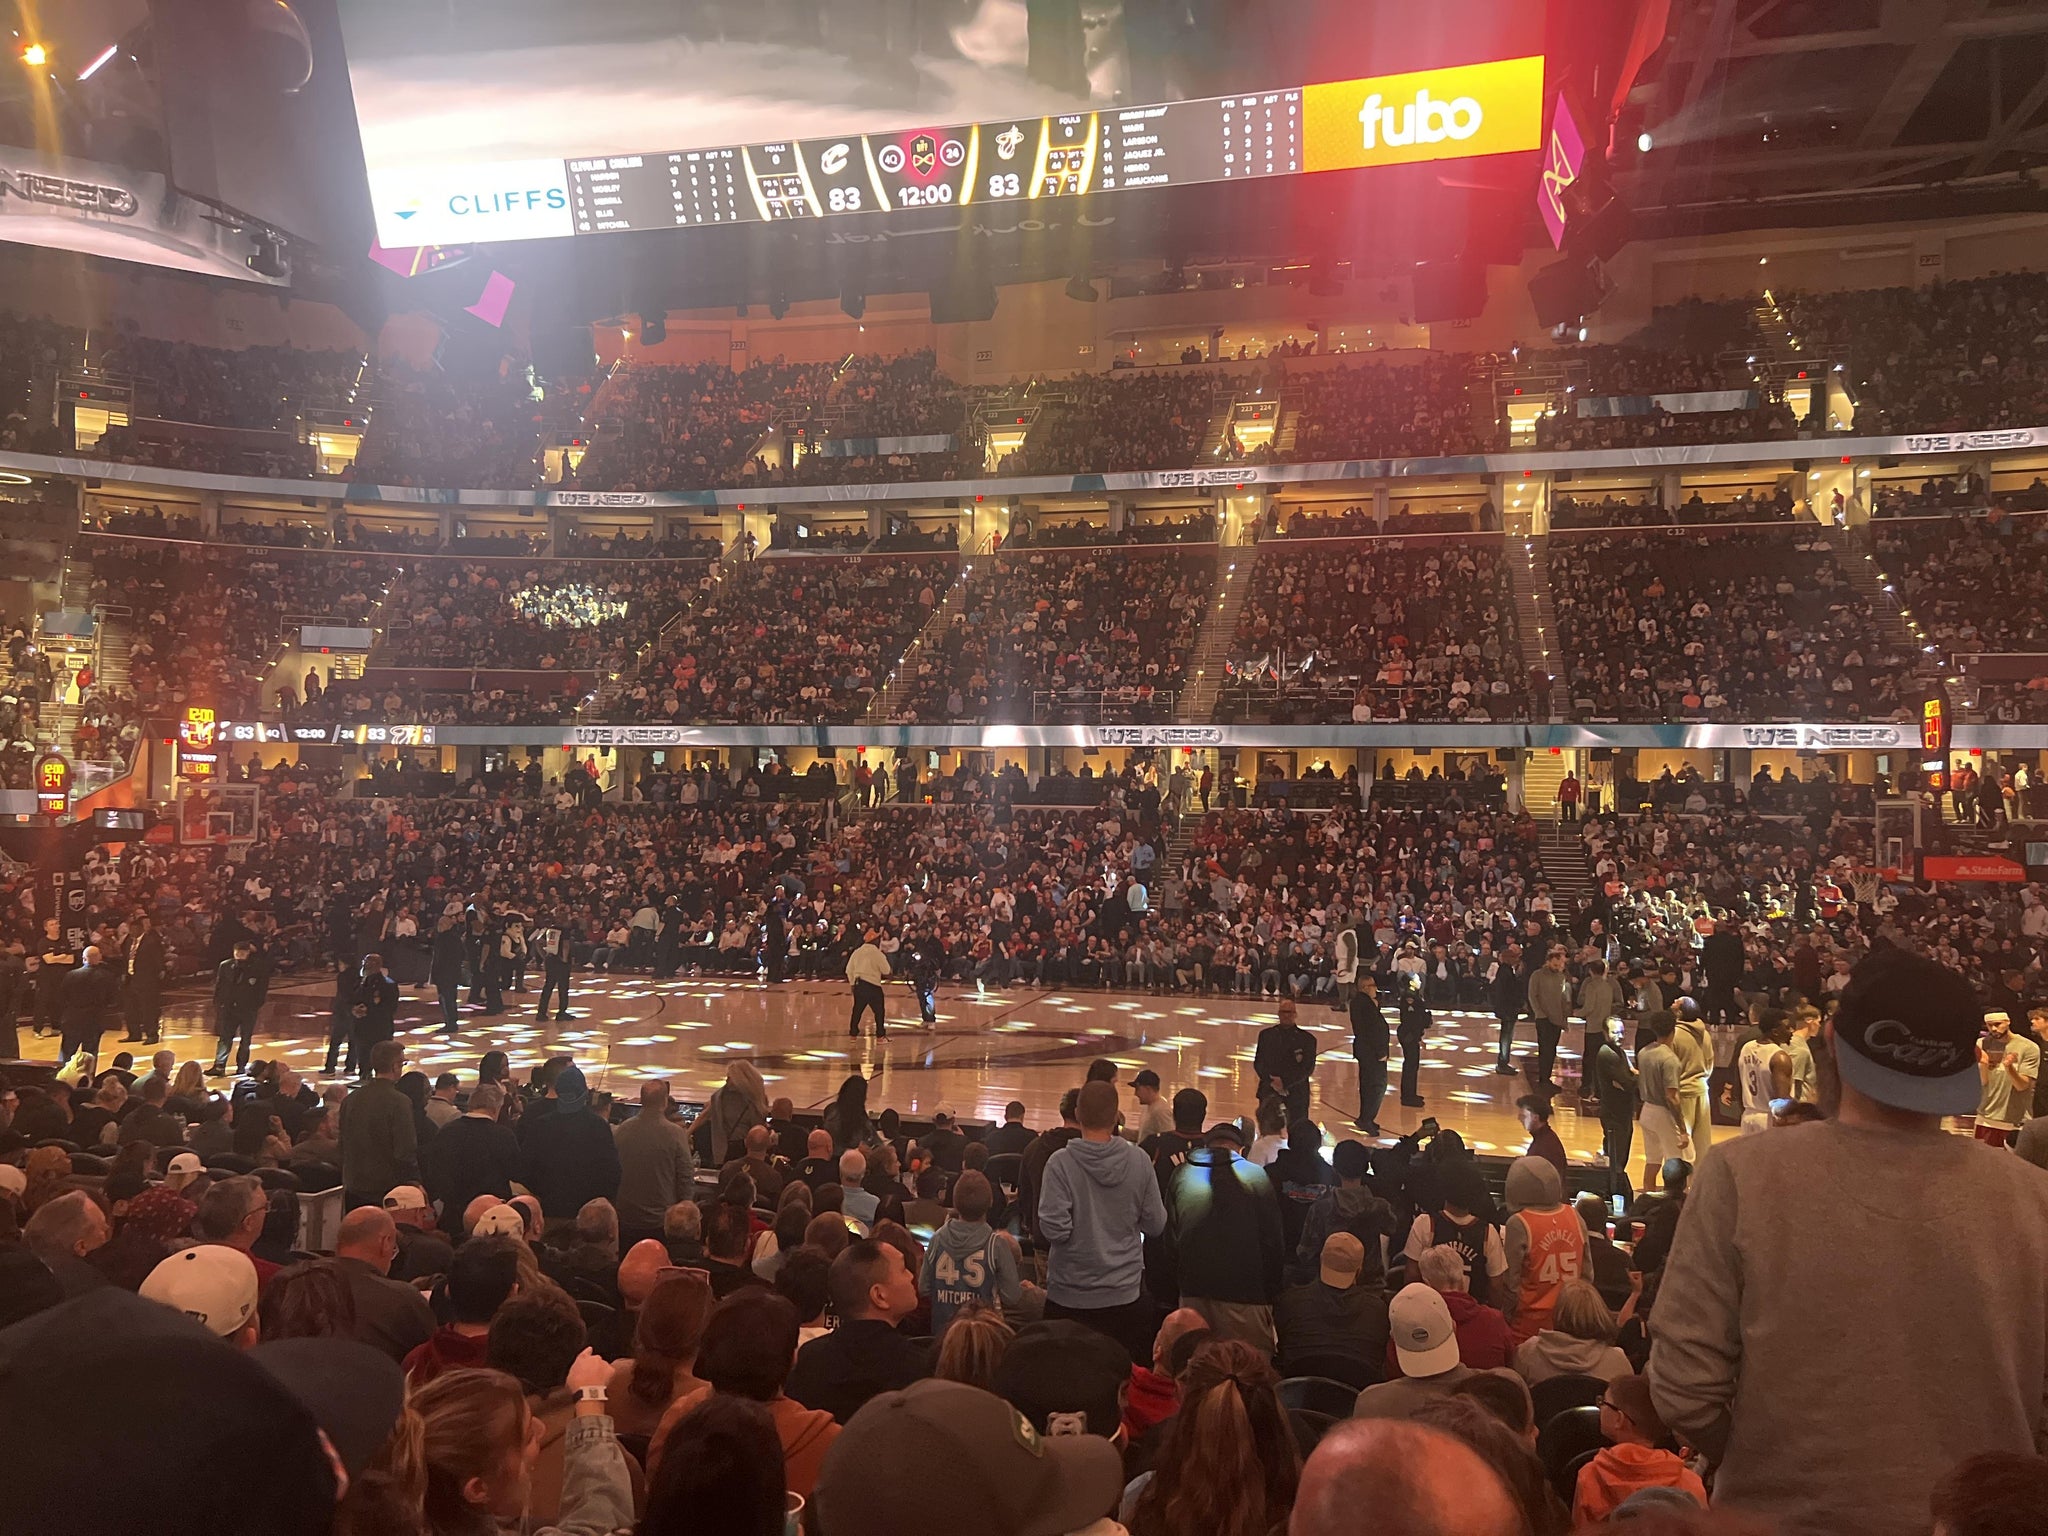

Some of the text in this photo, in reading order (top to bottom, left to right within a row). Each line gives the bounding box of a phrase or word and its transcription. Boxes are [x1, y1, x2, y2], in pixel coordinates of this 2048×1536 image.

[1221, 100, 1235, 108] PTS
[1059, 116, 1081, 124] FOULS
[1103, 125, 1110, 135] 7
[1244, 111, 1251, 120] 7
[1289, 105, 1296, 115] 0
[1359, 88, 1483, 149] fubo
[1065, 126, 1073, 137] 0
[1123, 135, 1158, 146] LARSSON
[765, 145, 785, 153] FOULS
[946, 148, 959, 159] 24
[1103, 152, 1112, 162] 11
[1123, 149, 1152, 160] JAQUEZ
[1224, 140, 1230, 150] 7
[772, 154, 780, 165] 0
[885, 154, 897, 165] 4Q
[708, 163, 715, 173] 7
[1124, 163, 1150, 173] HERRO
[671, 179, 677, 188] 7
[989, 173, 1020, 197] 83
[727, 186, 735, 196] 0
[899, 184, 952, 206] 12:00
[449, 188, 566, 215] CLIFFS
[829, 187, 861, 212] 83
[597, 220, 630, 230] MITCHELL
[1906, 432, 2033, 451] WE NEED
[1160, 470, 1257, 486] WE NEED
[558, 493, 646, 505] WE NEED
[1098, 548, 1112, 556] 10
[234, 726, 386, 740] 83 4Q 12:00 24 83
[576, 729, 681, 743] WE NEED
[1099, 728, 1222, 744] WE NEED
[1743, 728, 1900, 745] WE NEED
[44, 774, 61, 787] 24
[1749, 1070, 1758, 1097] 3
[1538, 1228, 1577, 1251] MITCHELL
[935, 1250, 986, 1288] 45
[1539, 1251, 1578, 1284] 45
